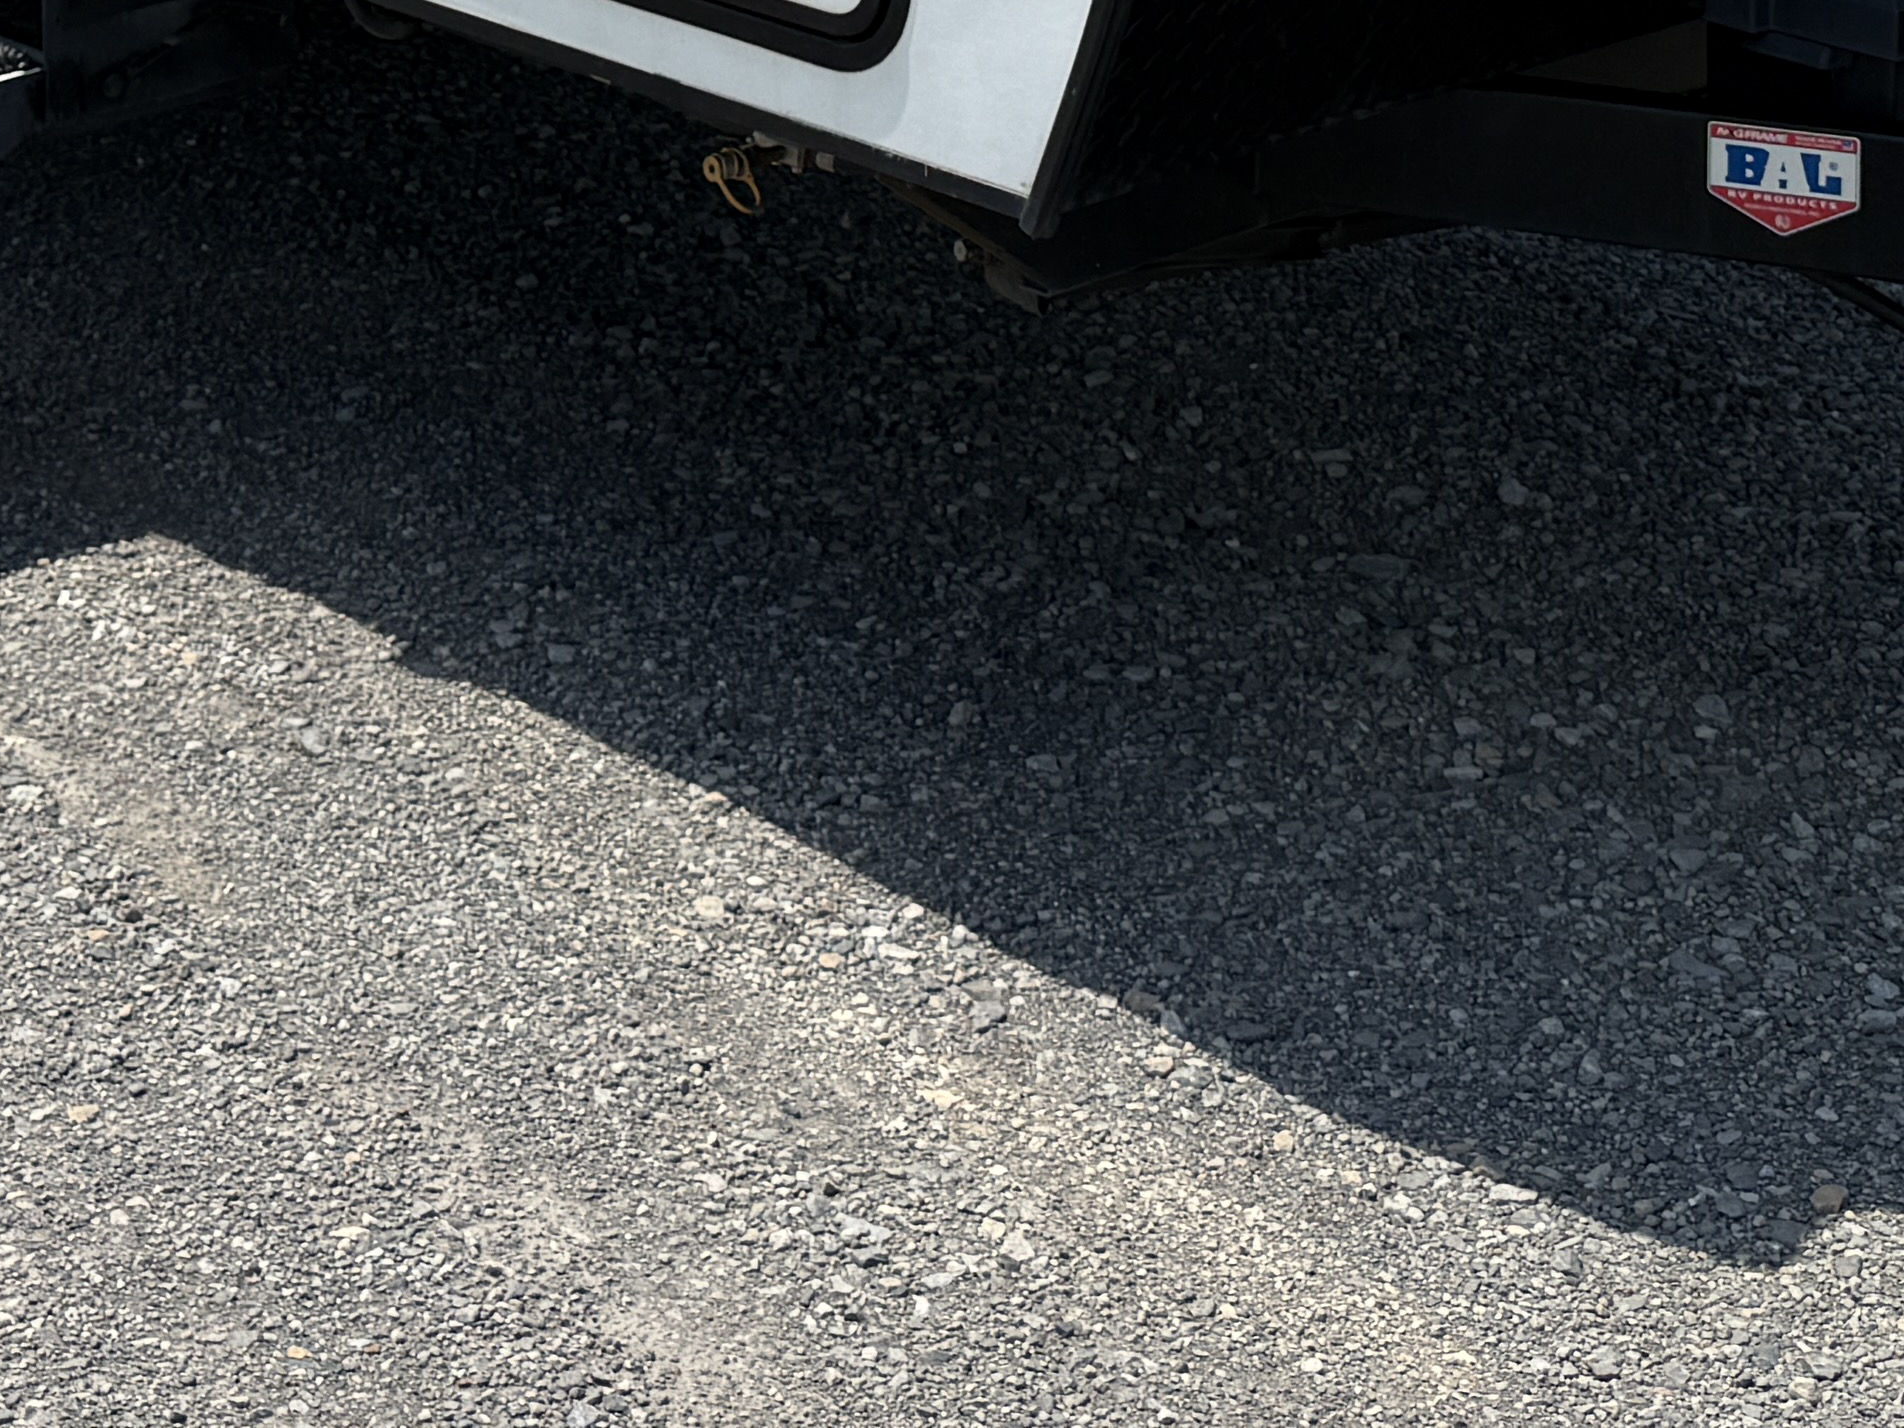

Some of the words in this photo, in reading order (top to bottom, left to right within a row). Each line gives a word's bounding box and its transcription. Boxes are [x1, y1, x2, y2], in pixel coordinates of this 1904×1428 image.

[1724, 143, 1843, 196] BAL
[1727, 189, 1748, 200] RV
[1752, 192, 1838, 211] PRODUCTS
